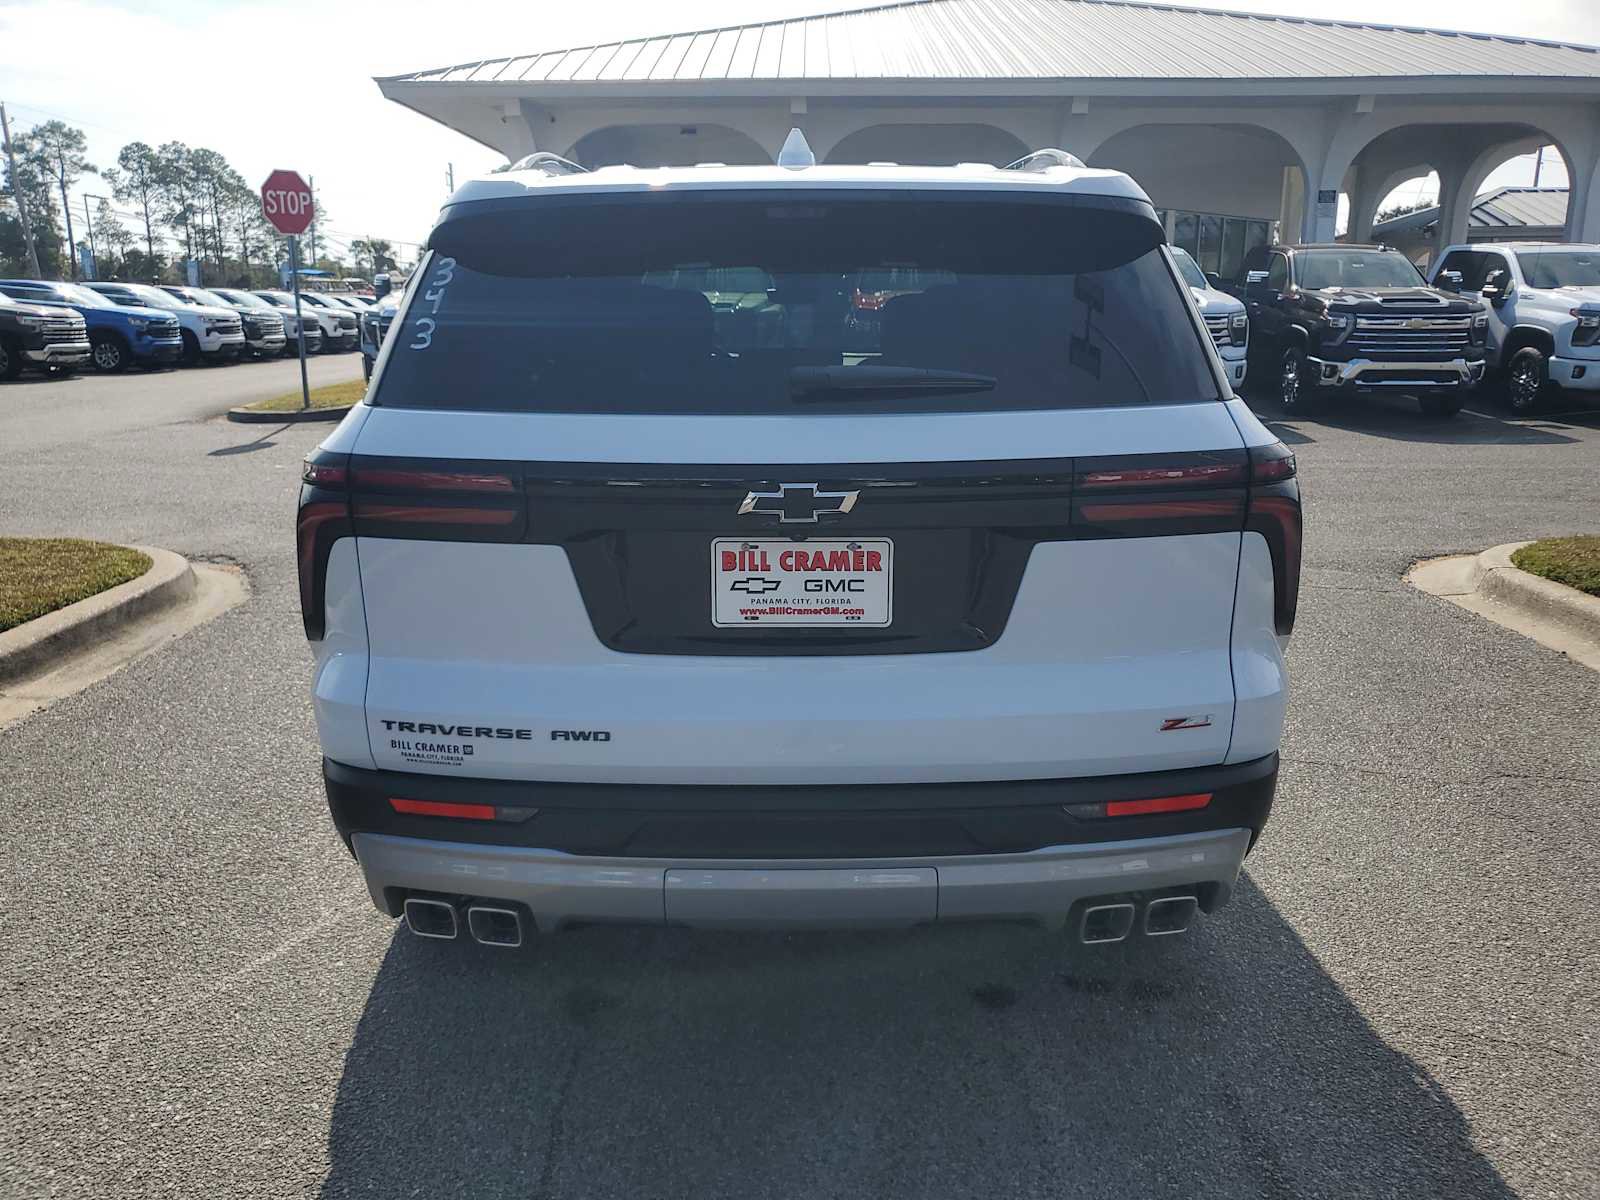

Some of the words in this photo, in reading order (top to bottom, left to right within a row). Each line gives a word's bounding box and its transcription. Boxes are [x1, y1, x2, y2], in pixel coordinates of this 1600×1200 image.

[266, 190, 311, 215] STOP
[721, 551, 771, 572] BILL
[779, 551, 882, 572] CRAMER
[804, 579, 865, 592] GMC
[792, 598, 813, 606] CITY,
[739, 607, 865, 616] www.BillCramerGM.com
[381, 720, 533, 740] TRAVERSE
[551, 730, 612, 742] AWD
[391, 739, 412, 750] BILL
[415, 742, 461, 754] CRAMER
